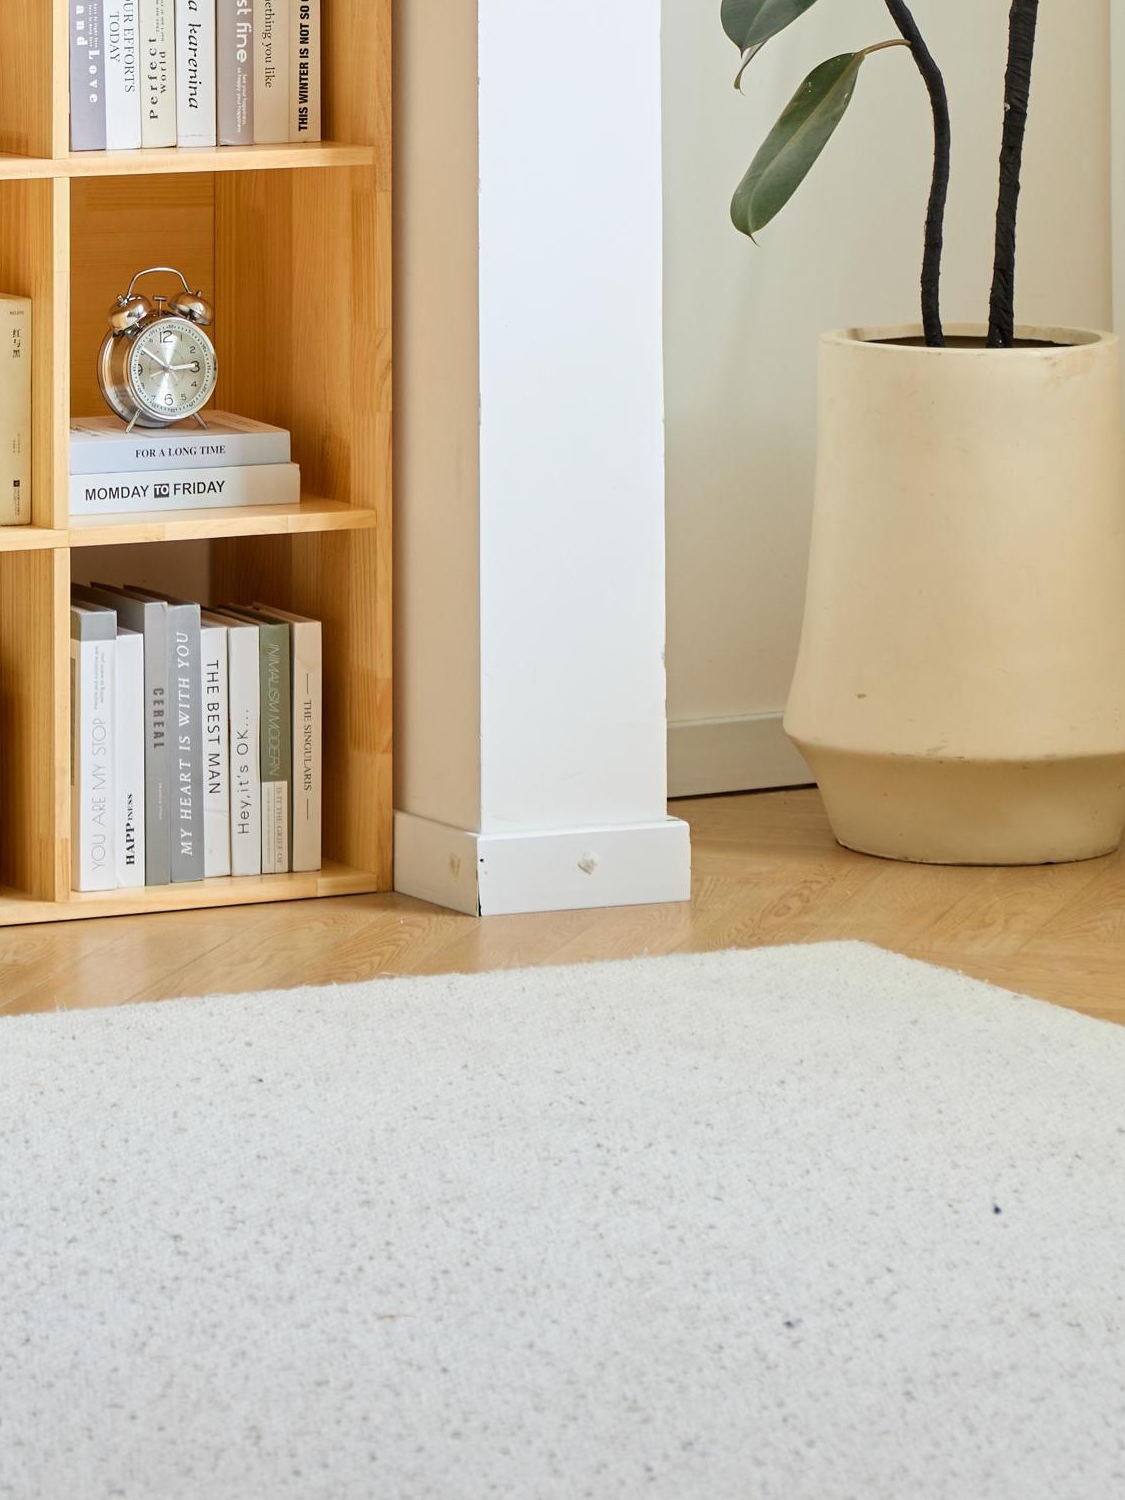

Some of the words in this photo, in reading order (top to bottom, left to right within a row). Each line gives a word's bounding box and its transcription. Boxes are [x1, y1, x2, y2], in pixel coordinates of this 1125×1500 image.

[299, 4, 310, 19] SO
[109, 12, 121, 62] TODAY
[237, 21, 252, 63] fine
[299, 22, 309, 45] NOT
[76, 5, 87, 46] and
[89, 50, 100, 103] Love
[123, 28, 135, 93] EFFORTS
[187, 23, 201, 108] karenina
[262, 42, 273, 63] you
[299, 49, 309, 59] IS
[148, 37, 159, 120] Perfect
[265, 67, 275, 88] like
[298, 61, 309, 103] WINTER
[298, 105, 308, 131] THIS
[12, 328, 21, 358] 红与黑
[159, 330, 173, 343] 12
[190, 360, 201, 373] 3
[165, 394, 173, 406] 6
[135, 449, 156, 458] FOR
[159, 448, 166, 457] A
[169, 447, 197, 456] LONG
[200, 445, 226, 454] TIME
[85, 485, 149, 501] MOMDAY
[154, 484, 169, 497] TO
[174, 481, 225, 495] FRIDAY
[177, 632, 189, 668] YOU
[207, 660, 219, 694] THE
[153, 688, 165, 748] CEREAL
[177, 677, 191, 728] WITH
[303, 700, 312, 722] THE
[92, 718, 107, 756] STOP
[207, 702, 220, 745] BEST
[179, 736, 191, 752] IS
[304, 724, 313, 790] SINGULARIS
[91, 763, 107, 789] MY
[179, 760, 192, 820] HEART
[208, 753, 221, 794] MAN
[91, 797, 106, 827] ARE
[126, 794, 135, 865] HAPPINESS
[180, 827, 193, 856] MY
[91, 835, 106, 870] YOU
